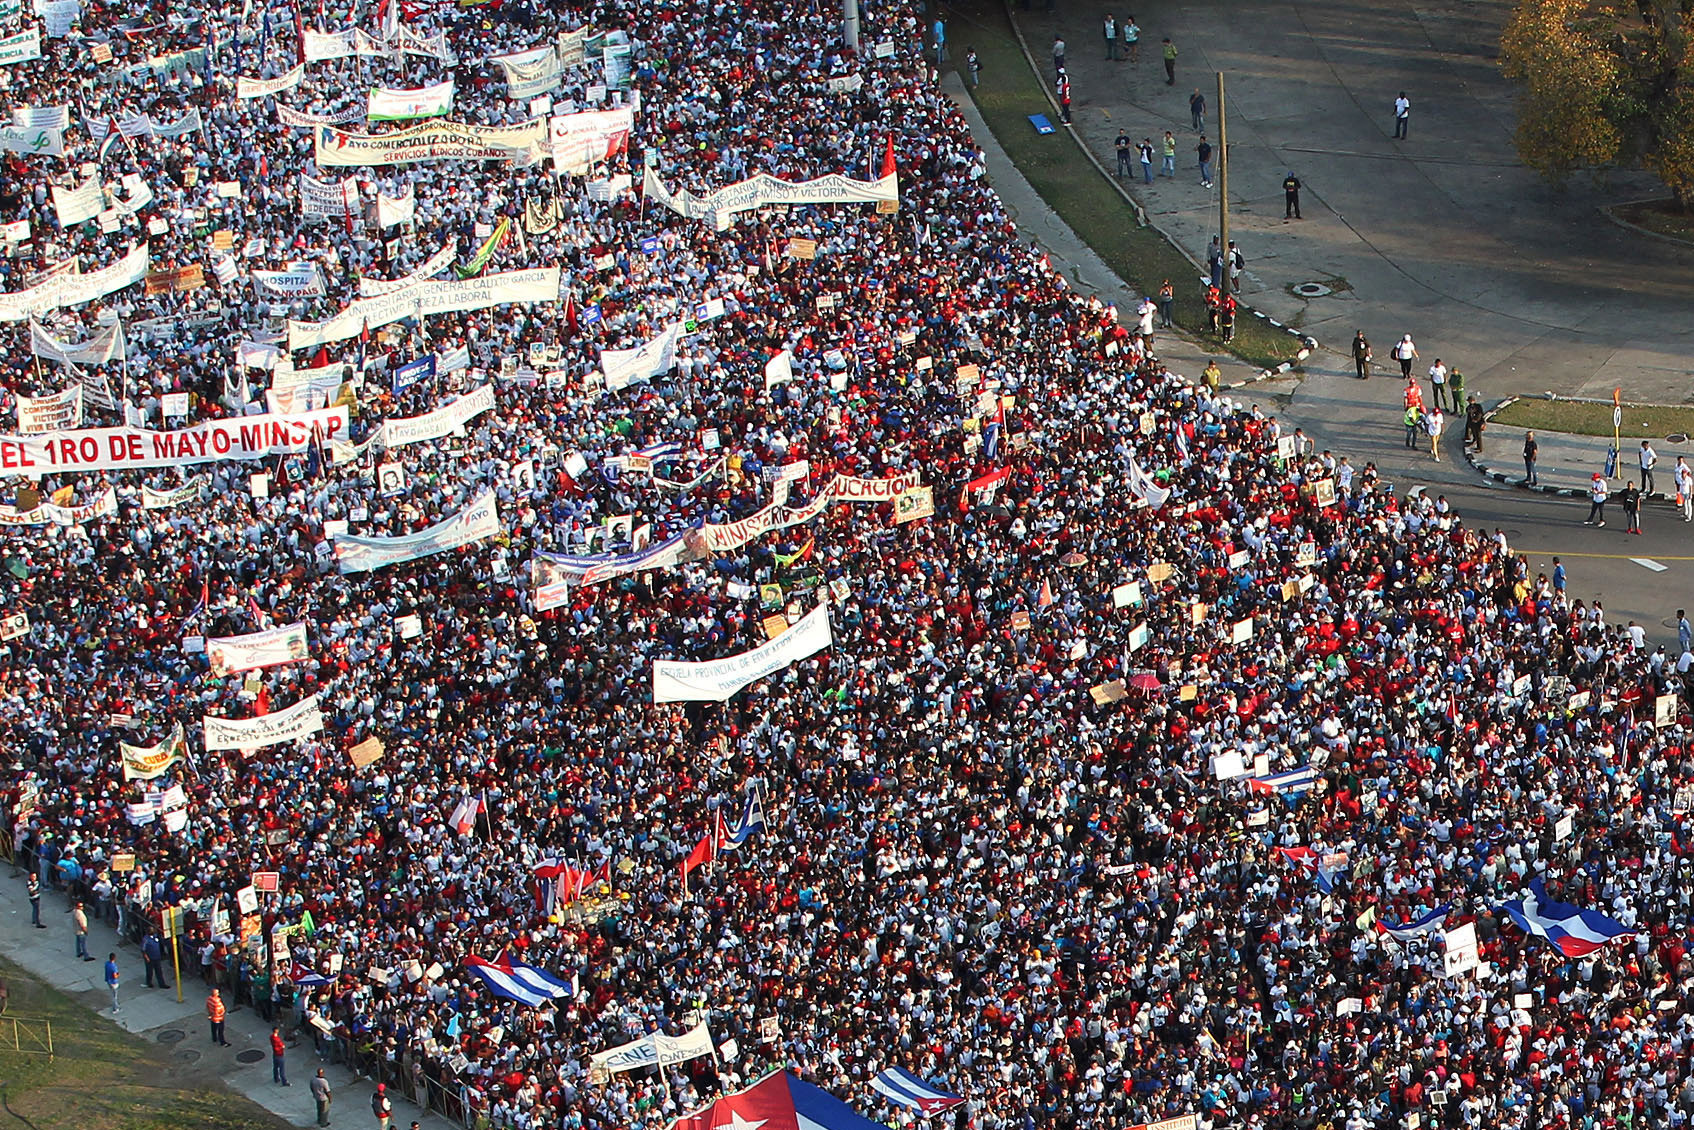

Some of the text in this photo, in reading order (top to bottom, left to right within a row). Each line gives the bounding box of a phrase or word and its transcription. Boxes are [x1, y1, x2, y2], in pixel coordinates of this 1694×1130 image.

[384, 150, 426, 162] SERVICIOS
[466, 150, 506, 158] CUBANOS
[801, 188, 848, 198] VICTORIA
[262, 275, 309, 286] HOSPITAL
[473, 272, 509, 289] CALIXTO
[262, 287, 295, 298] FRANK
[448, 290, 492, 306] LABORAL
[2, 442, 34, 468] EL
[45, 437, 98, 464] 1RO
[109, 435, 144, 461] DE
[73, 498, 105, 519] MAYO
